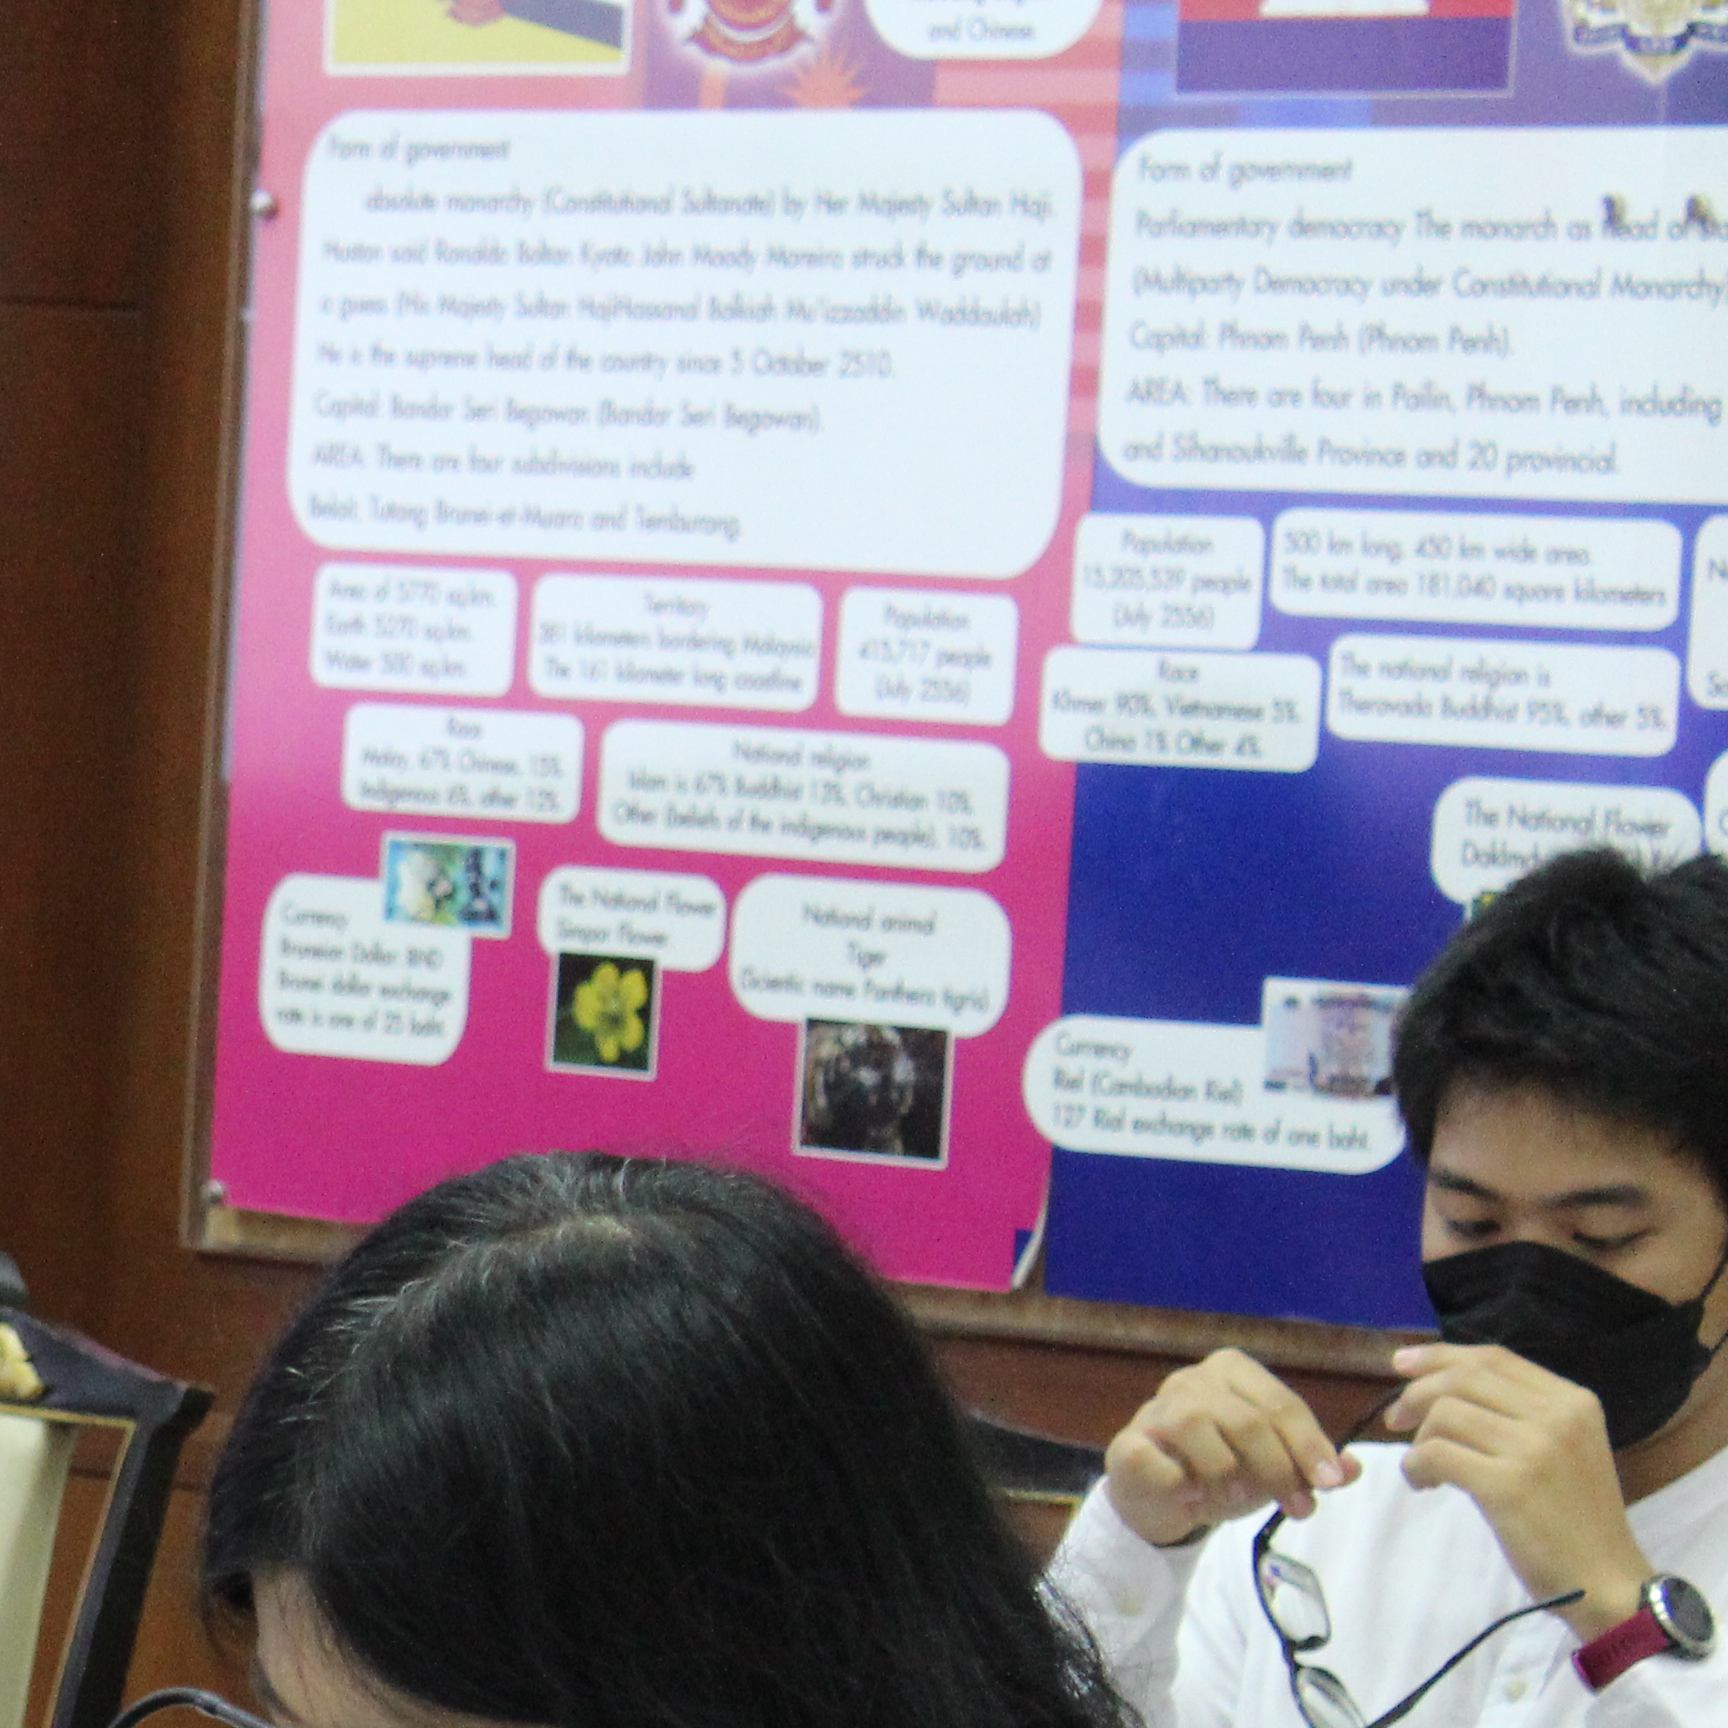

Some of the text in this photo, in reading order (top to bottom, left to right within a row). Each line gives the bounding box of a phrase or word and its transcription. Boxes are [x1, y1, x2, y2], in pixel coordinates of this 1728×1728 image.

[1198, 149, 1225, 184] of
[1228, 156, 1355, 193] government
[1134, 206, 1281, 250] Parliamentary
[1286, 204, 1407, 250] democracy
[1413, 206, 1453, 242] The
[1459, 205, 1559, 242] monarch
[1252, 263, 1374, 306] Democracy
[1380, 262, 1445, 299] under
[1201, 374, 1259, 409] There
[1266, 388, 1304, 410] are
[1361, 381, 1383, 411] in
[1618, 379, 1724, 429] including
[1121, 429, 1166, 464] and
[1315, 435, 1408, 469] Province
[1414, 435, 1461, 471] and
[1377, 654, 1455, 684] national
[1458, 655, 1530, 692] religion
[1506, 802, 1598, 837] National
